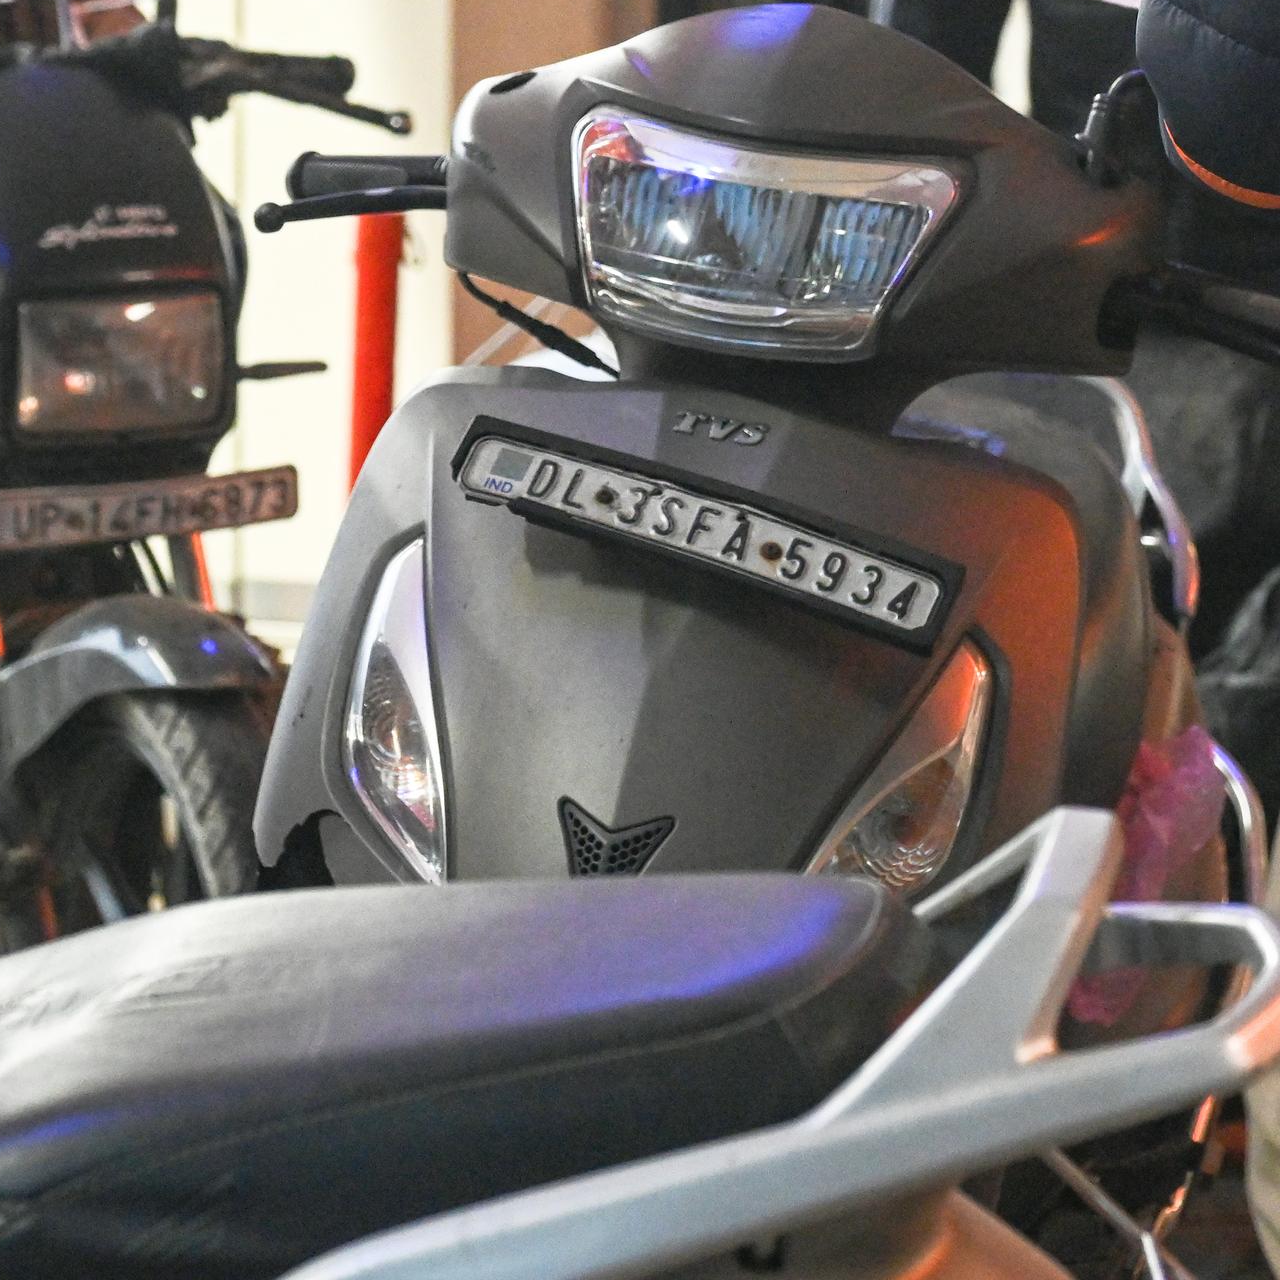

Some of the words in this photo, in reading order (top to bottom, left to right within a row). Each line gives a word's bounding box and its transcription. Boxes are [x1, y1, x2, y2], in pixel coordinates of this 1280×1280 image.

[672, 409, 770, 447] TVS
[483, 477, 514, 494] IND
[13, 502, 64, 539] UP
[526, 458, 586, 510] DL
[617, 486, 750, 563] 3SFA
[779, 536, 921, 622] 5934
